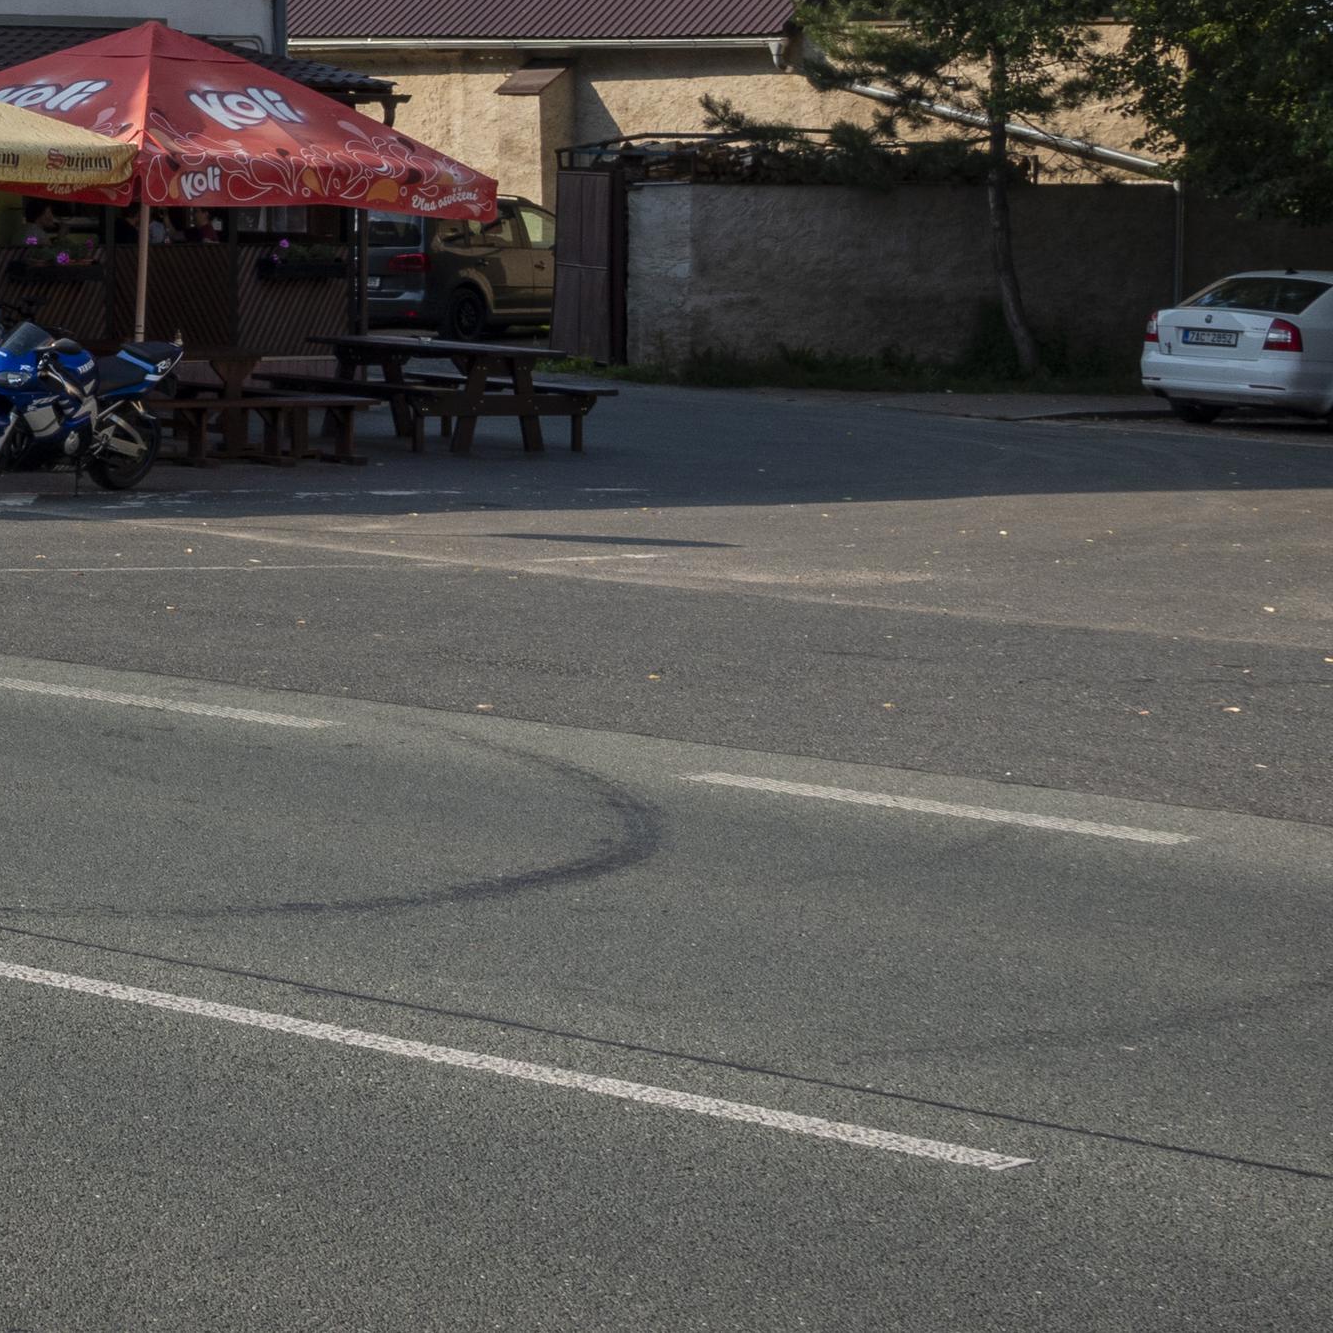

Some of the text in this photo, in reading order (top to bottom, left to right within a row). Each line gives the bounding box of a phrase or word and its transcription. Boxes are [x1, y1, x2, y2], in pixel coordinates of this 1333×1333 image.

[189, 87, 304, 130] Koli
[45, 147, 113, 172] Svijany
[180, 164, 221, 200] Koli
[412, 194, 437, 212] Vlna
